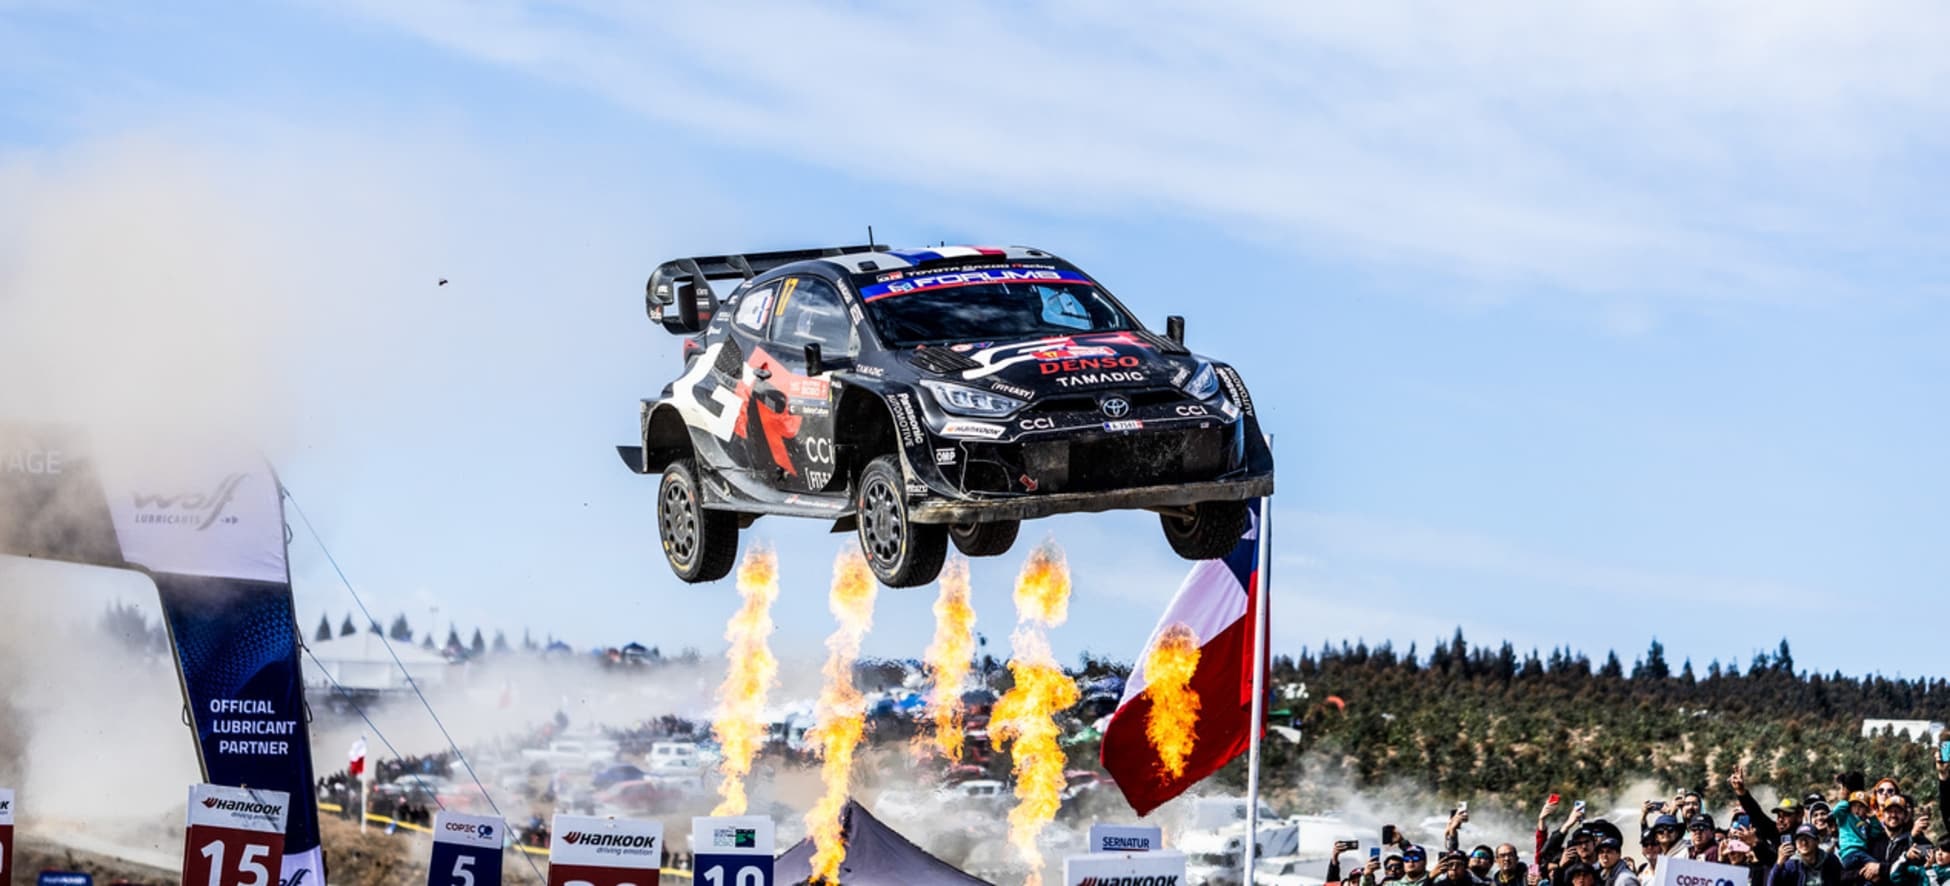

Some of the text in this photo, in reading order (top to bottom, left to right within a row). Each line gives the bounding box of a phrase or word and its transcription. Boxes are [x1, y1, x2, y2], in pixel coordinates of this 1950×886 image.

[1039, 356, 1139, 375] DENSO
[1056, 372, 1145, 388] TAMADIC
[1175, 405, 1208, 416] CCI
[897, 393, 925, 444] Panasonic
[1019, 417, 1055, 430] CCI
[936, 451, 956, 462] OMP
[210, 699, 276, 715] OFFICIAL
[213, 720, 297, 735] LUBRICANT
[219, 740, 289, 755] PARTNER
[1101, 836, 1150, 849] SERNATUR
[200, 839, 270, 886] 15
[452, 854, 476, 886] 5
